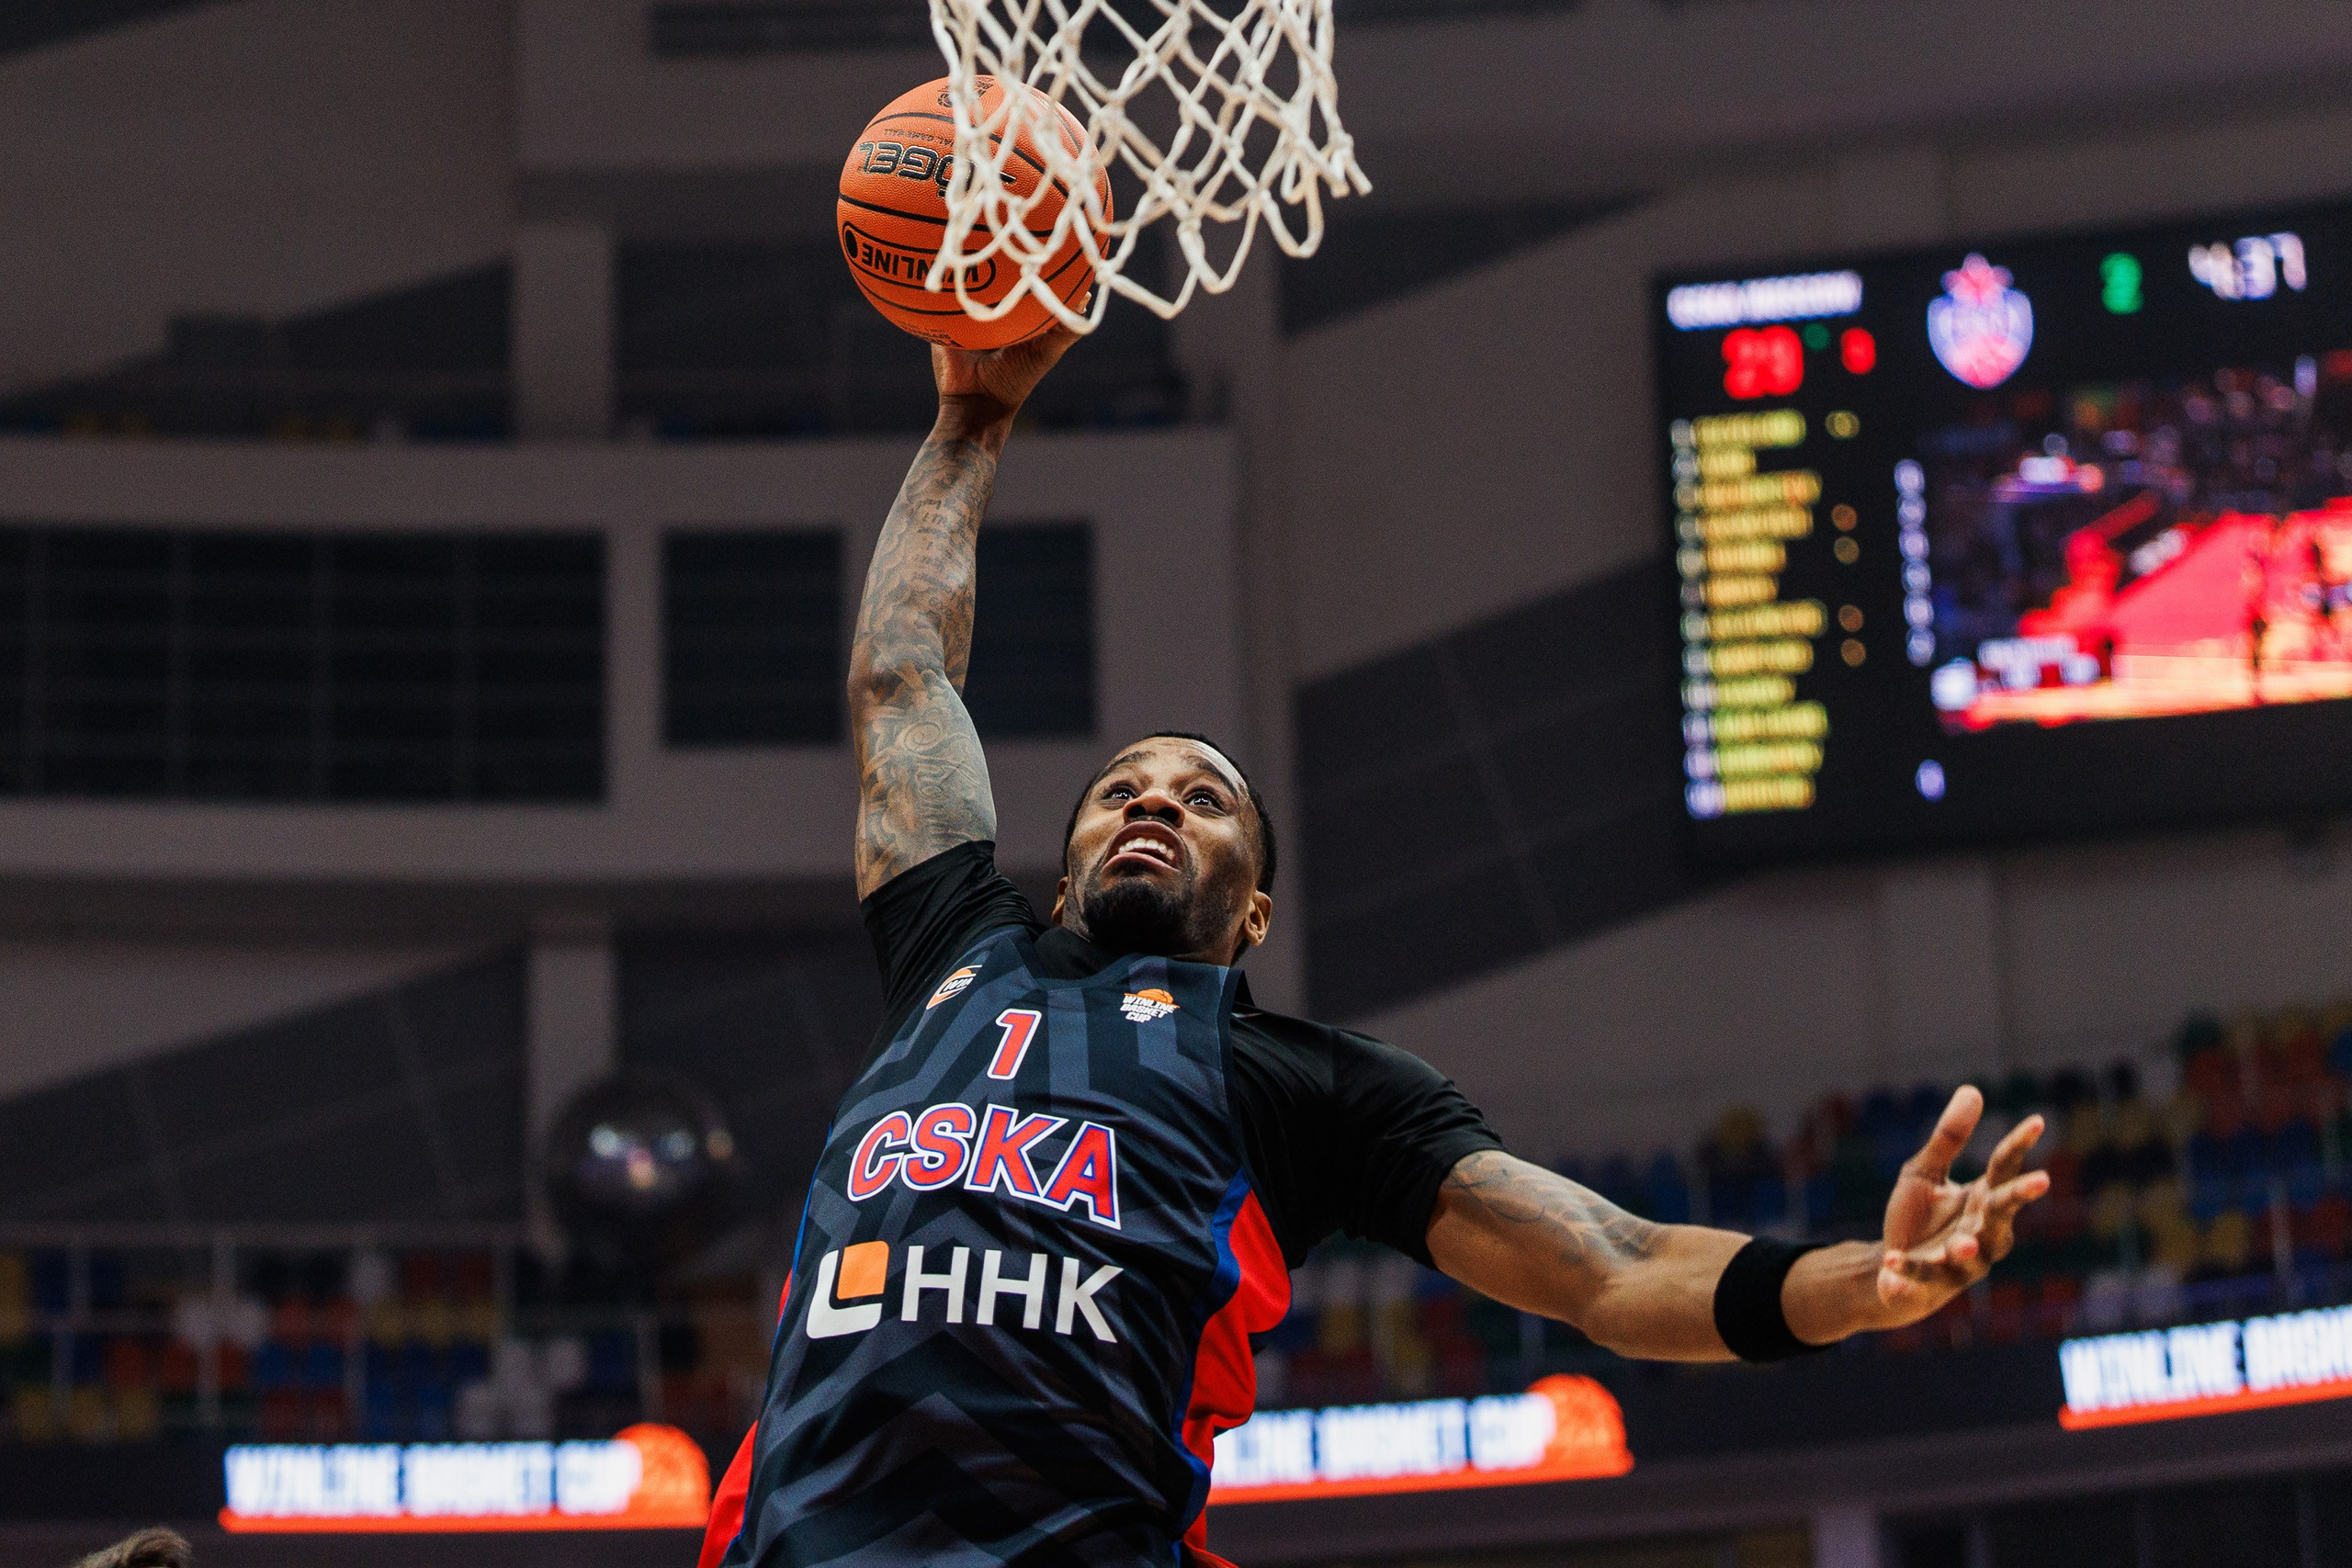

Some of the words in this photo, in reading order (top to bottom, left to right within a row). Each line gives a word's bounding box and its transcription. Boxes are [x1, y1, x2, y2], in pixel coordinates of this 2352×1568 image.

[861, 242, 980, 285] WNLINE
[1120, 1003, 1169, 1019] BASKET
[1122, 995, 1175, 1014] WINLINE
[1125, 1011, 1152, 1023] CUP
[986, 1007, 1042, 1081] 1
[847, 1102, 1122, 1231] CSKA
